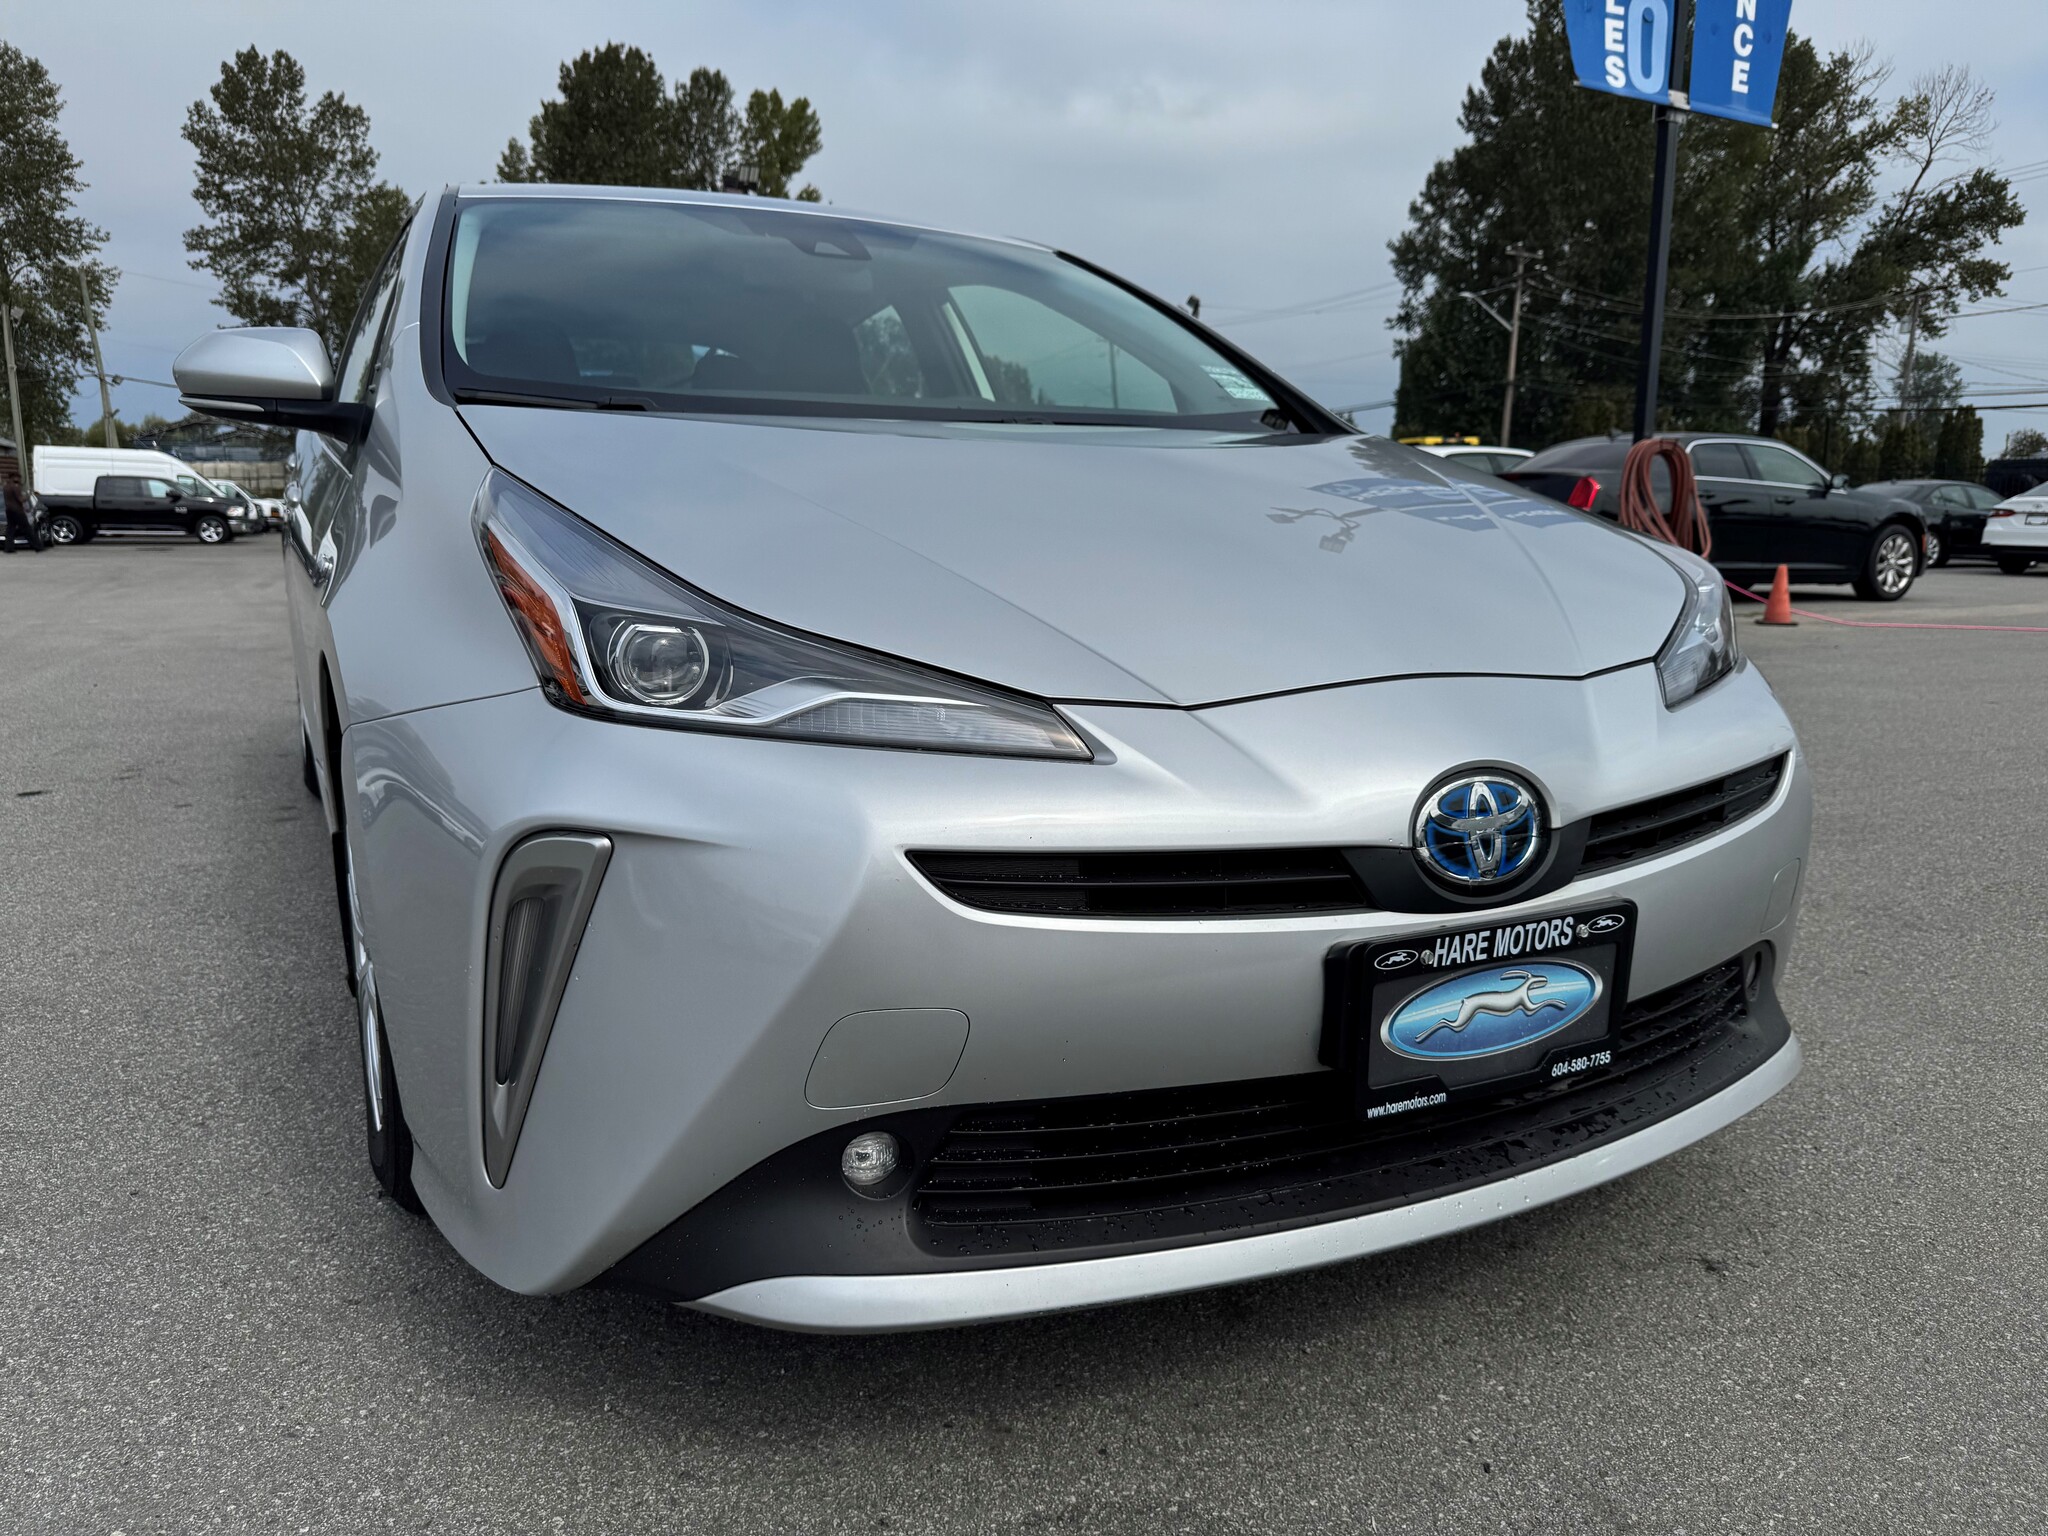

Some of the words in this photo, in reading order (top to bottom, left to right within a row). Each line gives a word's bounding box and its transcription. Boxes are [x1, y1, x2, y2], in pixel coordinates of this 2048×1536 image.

[1433, 931, 1490, 967] HARE
[1493, 916, 1574, 958] MOTORS
[1551, 1051, 1611, 1077] 604-580-7755
[1367, 1091, 1446, 1118] www.haremotors.com
